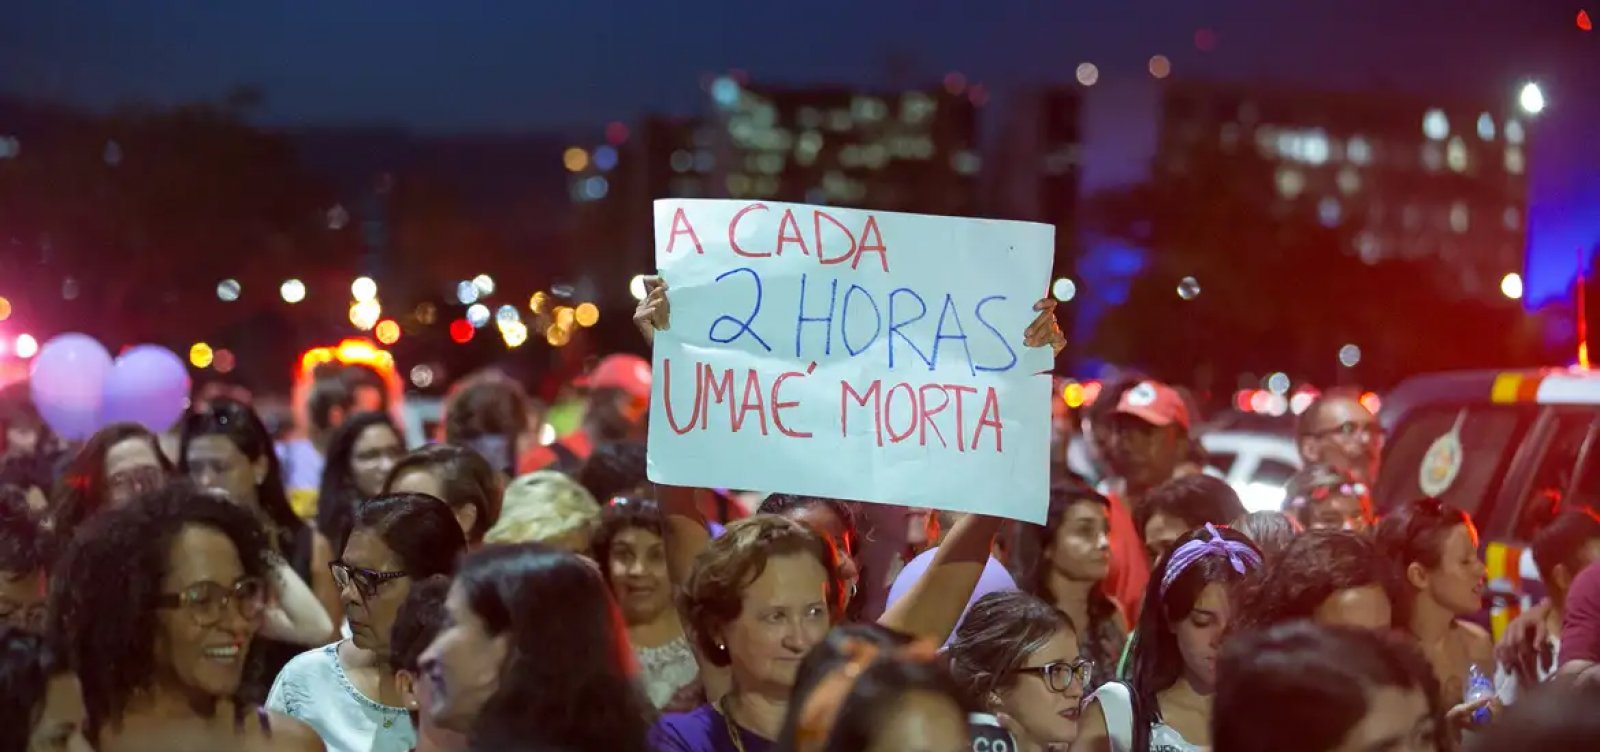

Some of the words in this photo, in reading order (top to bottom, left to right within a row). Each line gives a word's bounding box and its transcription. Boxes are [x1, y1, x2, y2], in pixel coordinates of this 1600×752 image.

[666, 208, 704, 254] A
[729, 203, 889, 272] CADA
[709, 268, 771, 352] 2
[796, 273, 1017, 376] HORAS
[840, 379, 1003, 453] MORTA
